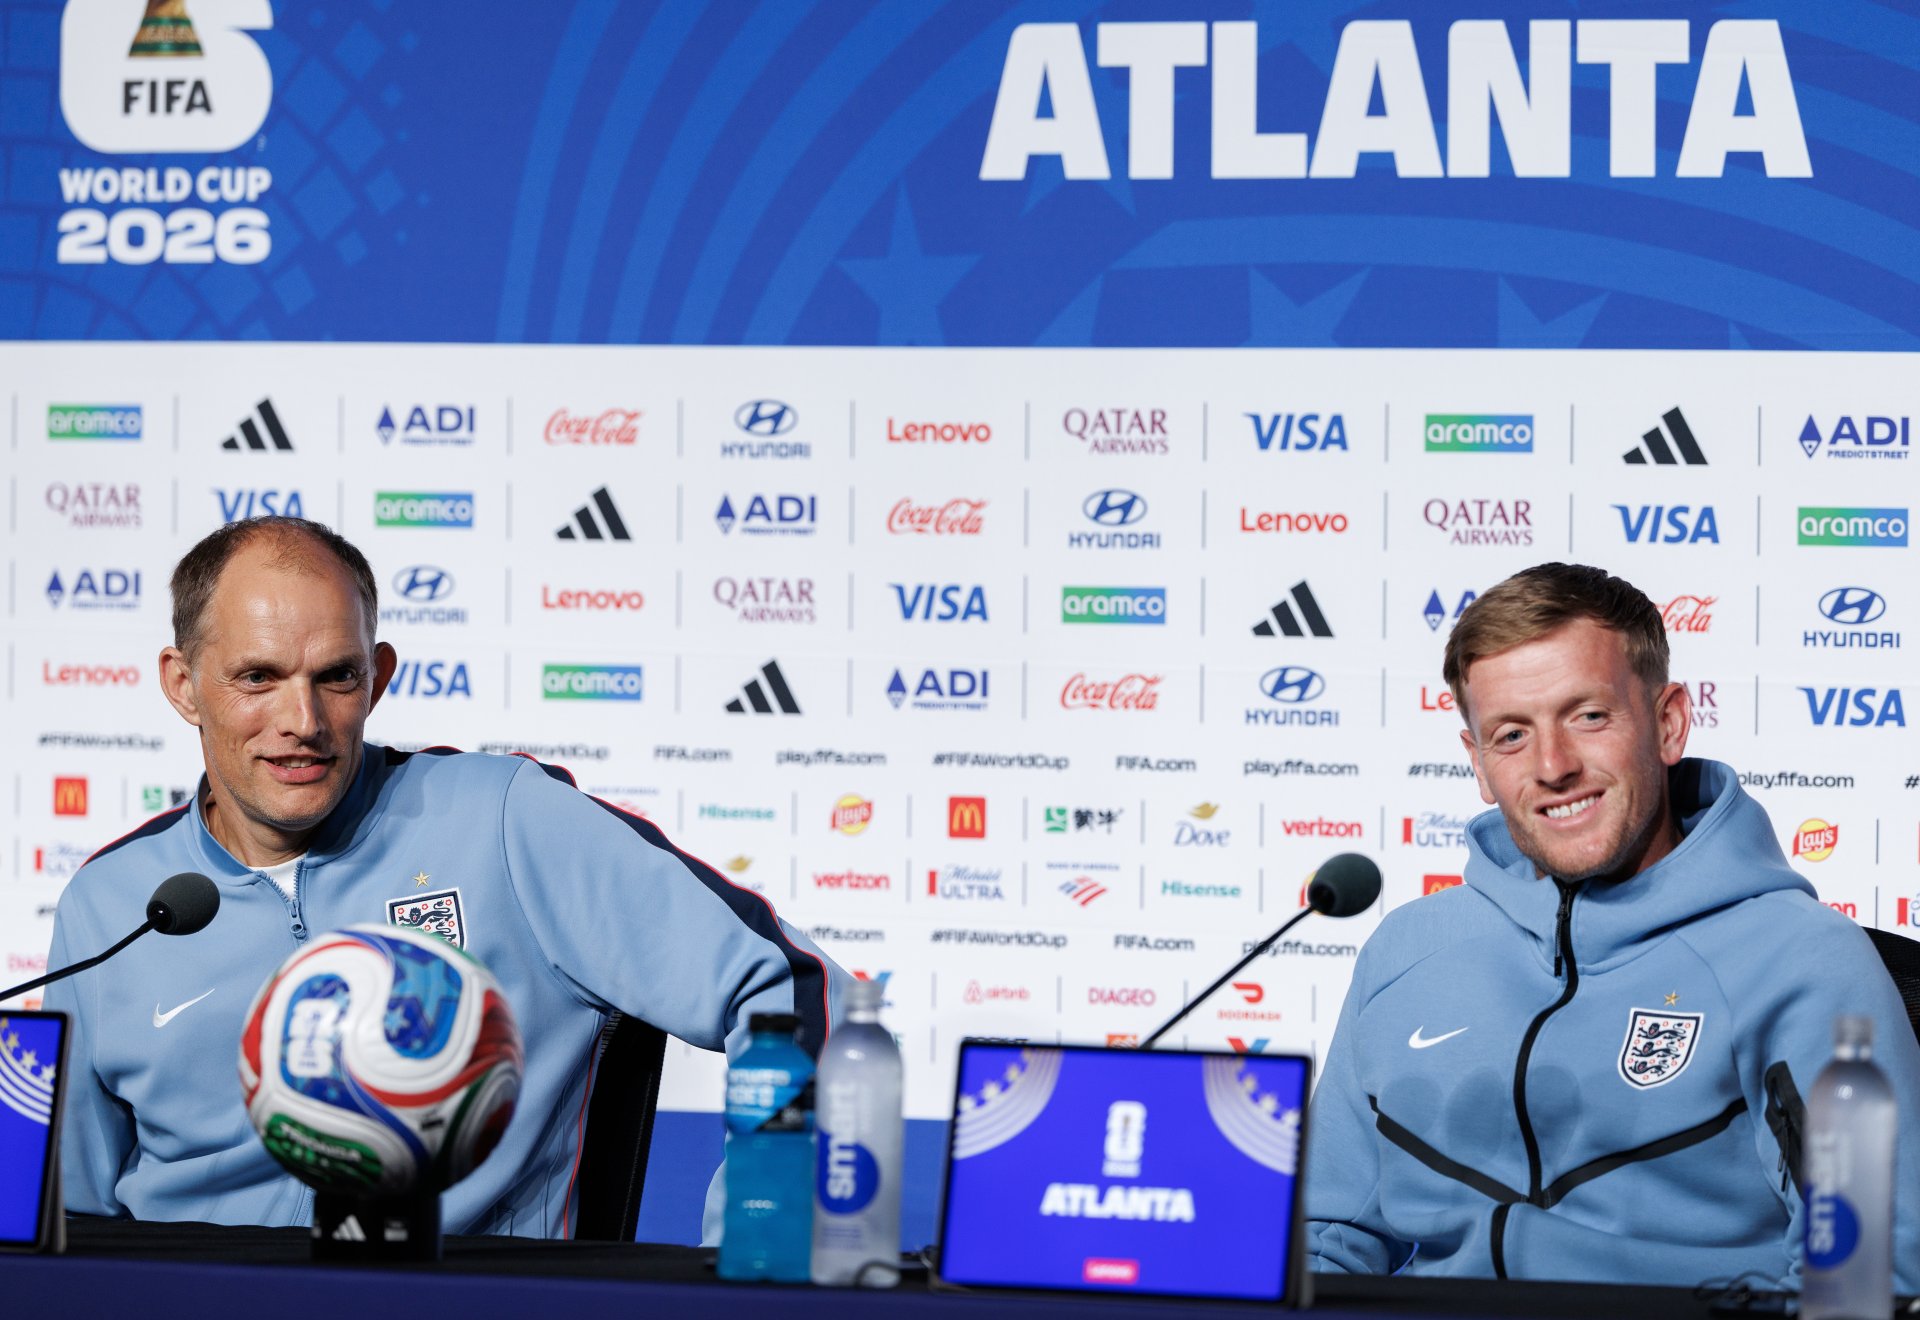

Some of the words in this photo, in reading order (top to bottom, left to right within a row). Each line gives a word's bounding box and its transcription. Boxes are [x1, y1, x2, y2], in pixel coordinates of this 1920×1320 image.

[121, 79, 213, 115] FIFA
[978, 18, 1814, 182] ATLANTA
[58, 167, 193, 203] WORLD
[196, 166, 273, 203] CUP
[56, 208, 273, 265] 2026
[48, 411, 142, 435] aramco
[404, 406, 475, 433] ADI
[887, 418, 991, 444] Lenovo
[1063, 407, 1168, 441] QATAR
[1242, 412, 1349, 451] VISA
[1828, 416, 1909, 446] ADI
[1090, 438, 1169, 455] AIRWAYS
[1426, 423, 1532, 446] aramco
[720, 442, 812, 459] HYUNDAI
[1827, 450, 1910, 460] PREDICTSTREET
[45, 482, 141, 514] QATAR
[211, 489, 305, 523] VISA
[377, 498, 474, 522] aramco
[744, 495, 816, 523] ADI
[1240, 508, 1348, 534] Lenovo
[1423, 498, 1533, 529] QATAR
[1610, 504, 1720, 544] VISA
[1451, 529, 1533, 546] AIRWAYS
[1799, 516, 1906, 539] aramco
[1068, 532, 1161, 549] HYUNDAI
[73, 570, 141, 597] ADI
[712, 576, 815, 609] QATAR
[541, 585, 644, 611] Lenovo
[888, 584, 989, 622] VISA
[1062, 594, 1165, 617] aramco
[739, 607, 817, 624] AIRWAYS
[1803, 631, 1900, 649] HYUNDAI
[43, 660, 140, 685] Lenovo
[388, 661, 471, 697] VISA
[543, 670, 642, 695] aramco
[915, 669, 989, 698] ADI
[1245, 709, 1339, 727] HYUNDAI
[1796, 687, 1906, 728] VISA
[932, 751, 1070, 771] #FIFAWorldCup
[1115, 756, 1197, 772] FIFA.com
[1243, 759, 1359, 777] play.fifa.com
[1173, 821, 1232, 847] Dove
[1282, 816, 1363, 838] verizon
[1415, 833, 1466, 848] ULTR
[1797, 827, 1835, 854] Lay's
[812, 871, 891, 890] verizon
[940, 884, 1004, 901] ULTRA
[1160, 879, 1242, 899] Hisense
[930, 928, 1068, 949] #FIFAWorldCup
[1114, 934, 1195, 951] FIFA.com
[1088, 986, 1156, 1007] DIAGEO
[1039, 1182, 1196, 1223] ATLANTA
